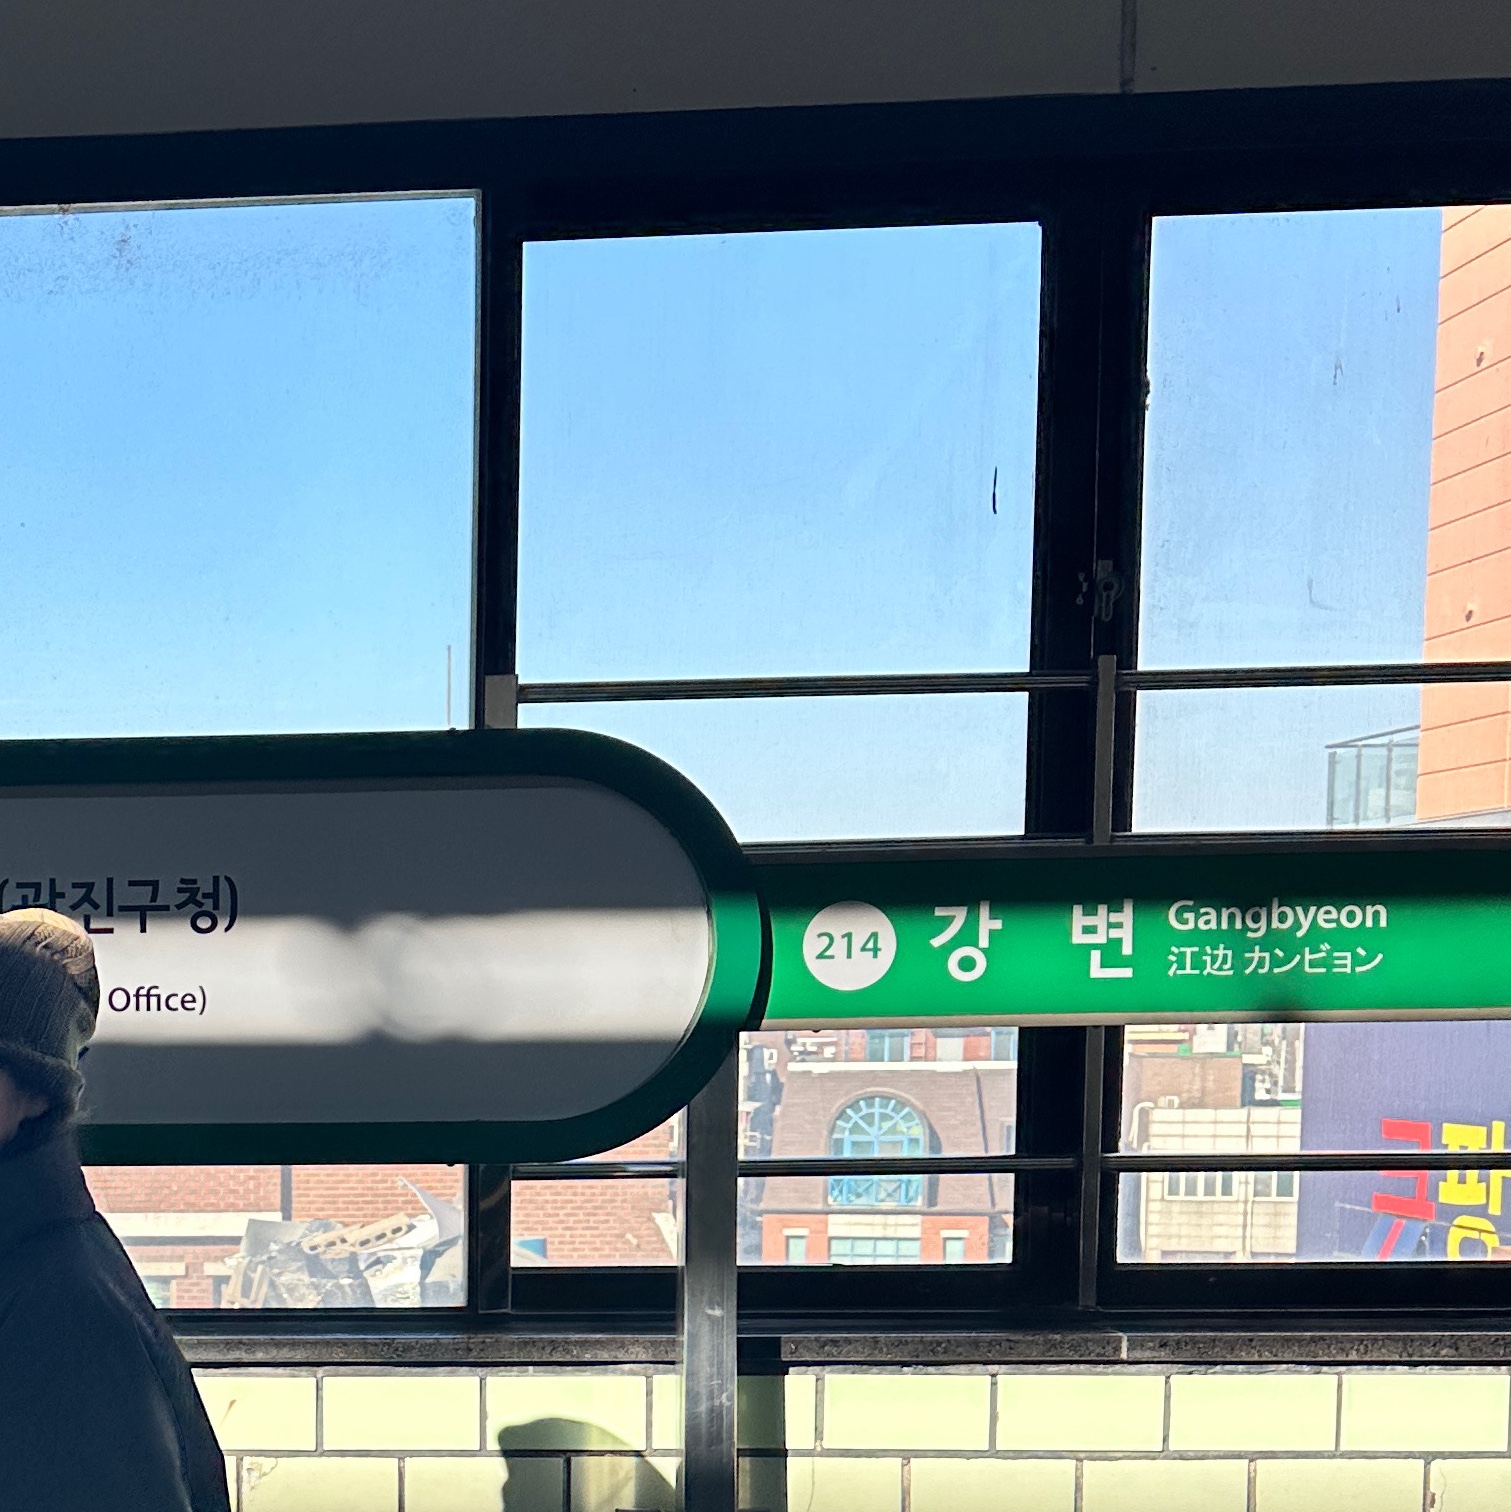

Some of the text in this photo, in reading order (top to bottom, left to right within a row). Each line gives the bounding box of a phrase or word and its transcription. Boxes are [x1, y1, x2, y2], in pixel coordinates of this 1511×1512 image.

[1168, 897, 1388, 938] Gangbyeon
[815, 931, 882, 960] 214
[1167, 942, 1384, 977] 江边 カンビョン
[108, 985, 206, 1015] Office)
